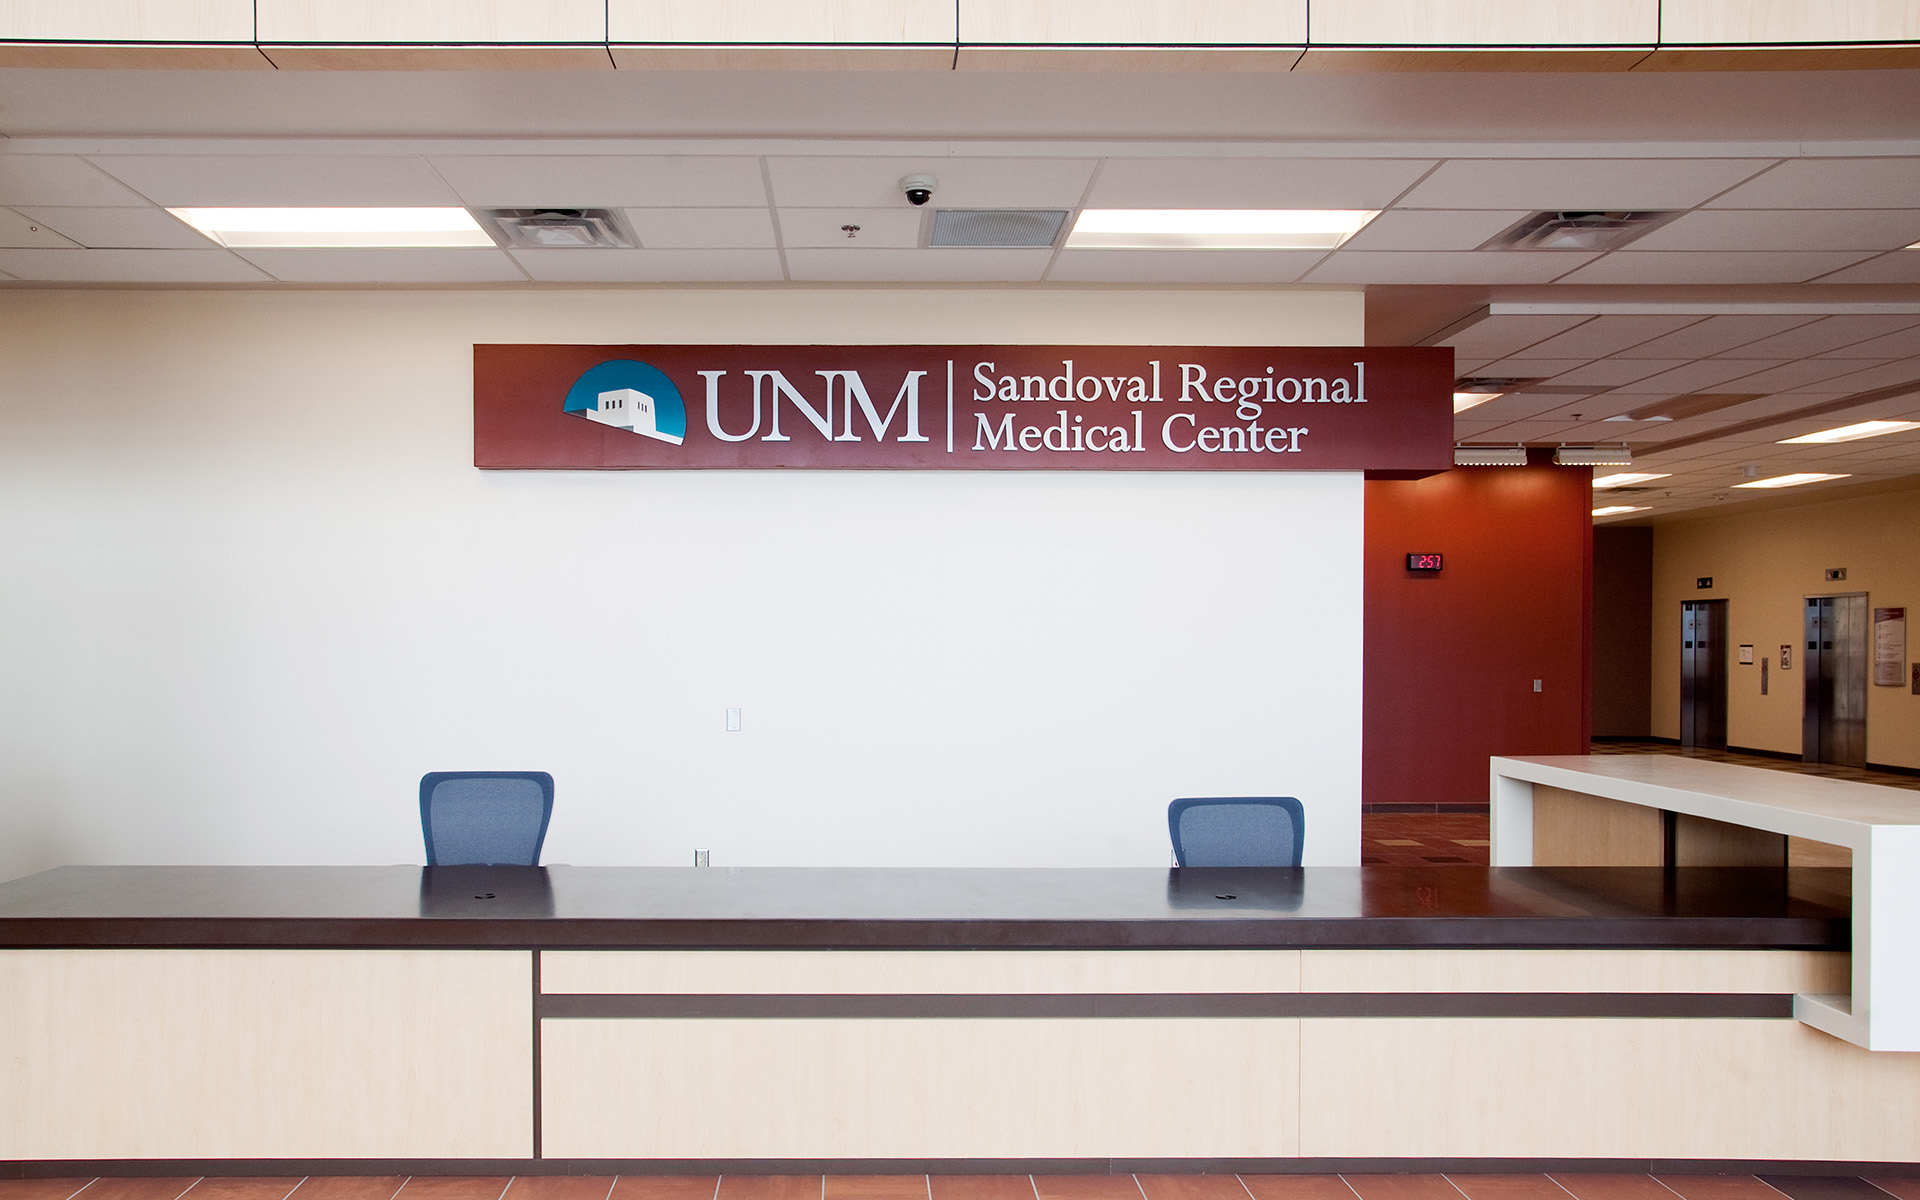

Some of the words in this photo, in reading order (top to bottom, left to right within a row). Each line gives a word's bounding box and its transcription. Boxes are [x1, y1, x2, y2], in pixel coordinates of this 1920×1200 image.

[696, 370, 930, 443] UNM
[973, 359, 1164, 403] Sandoval
[1177, 361, 1368, 421] Regional
[972, 409, 1146, 453] Medical
[1161, 411, 1309, 454] Center
